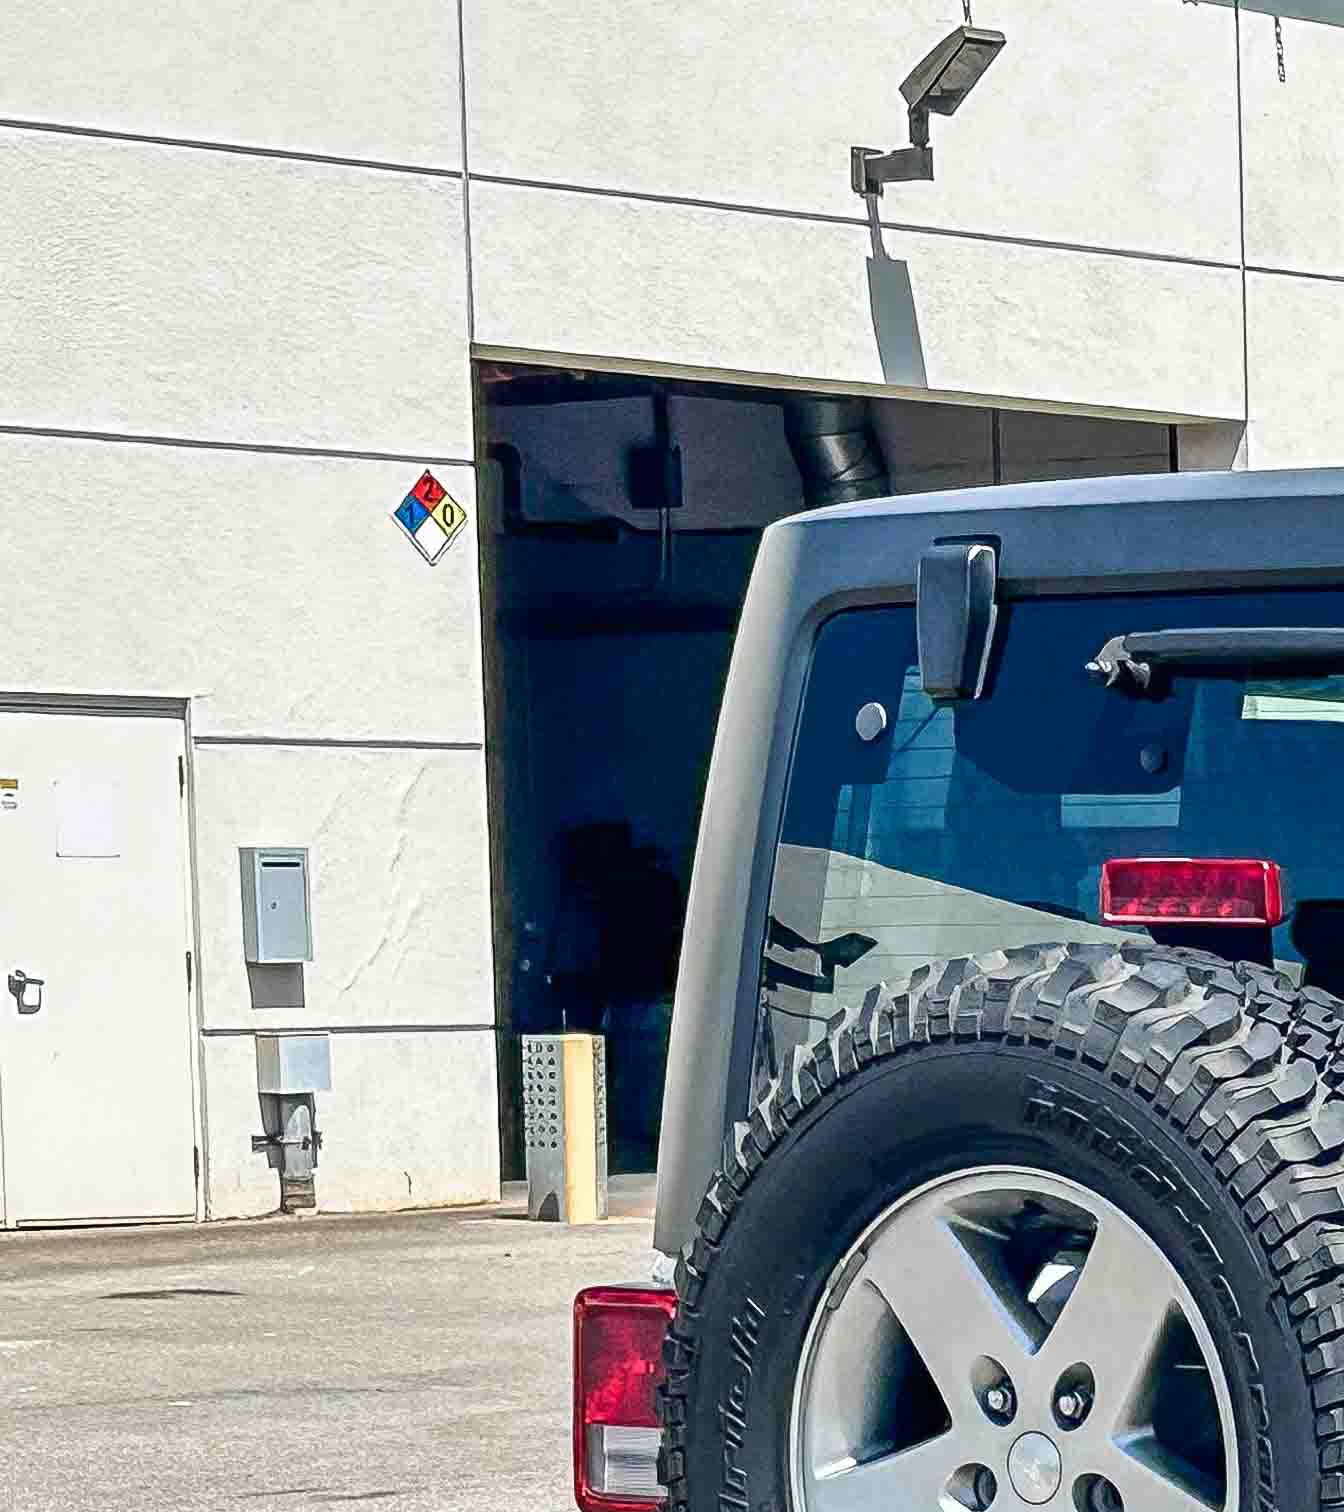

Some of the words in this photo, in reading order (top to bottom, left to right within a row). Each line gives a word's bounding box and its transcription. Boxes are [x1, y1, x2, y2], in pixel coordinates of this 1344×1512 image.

[422, 479, 436, 503] 2
[405, 503, 415, 530] 1
[442, 503, 455, 528] 0
